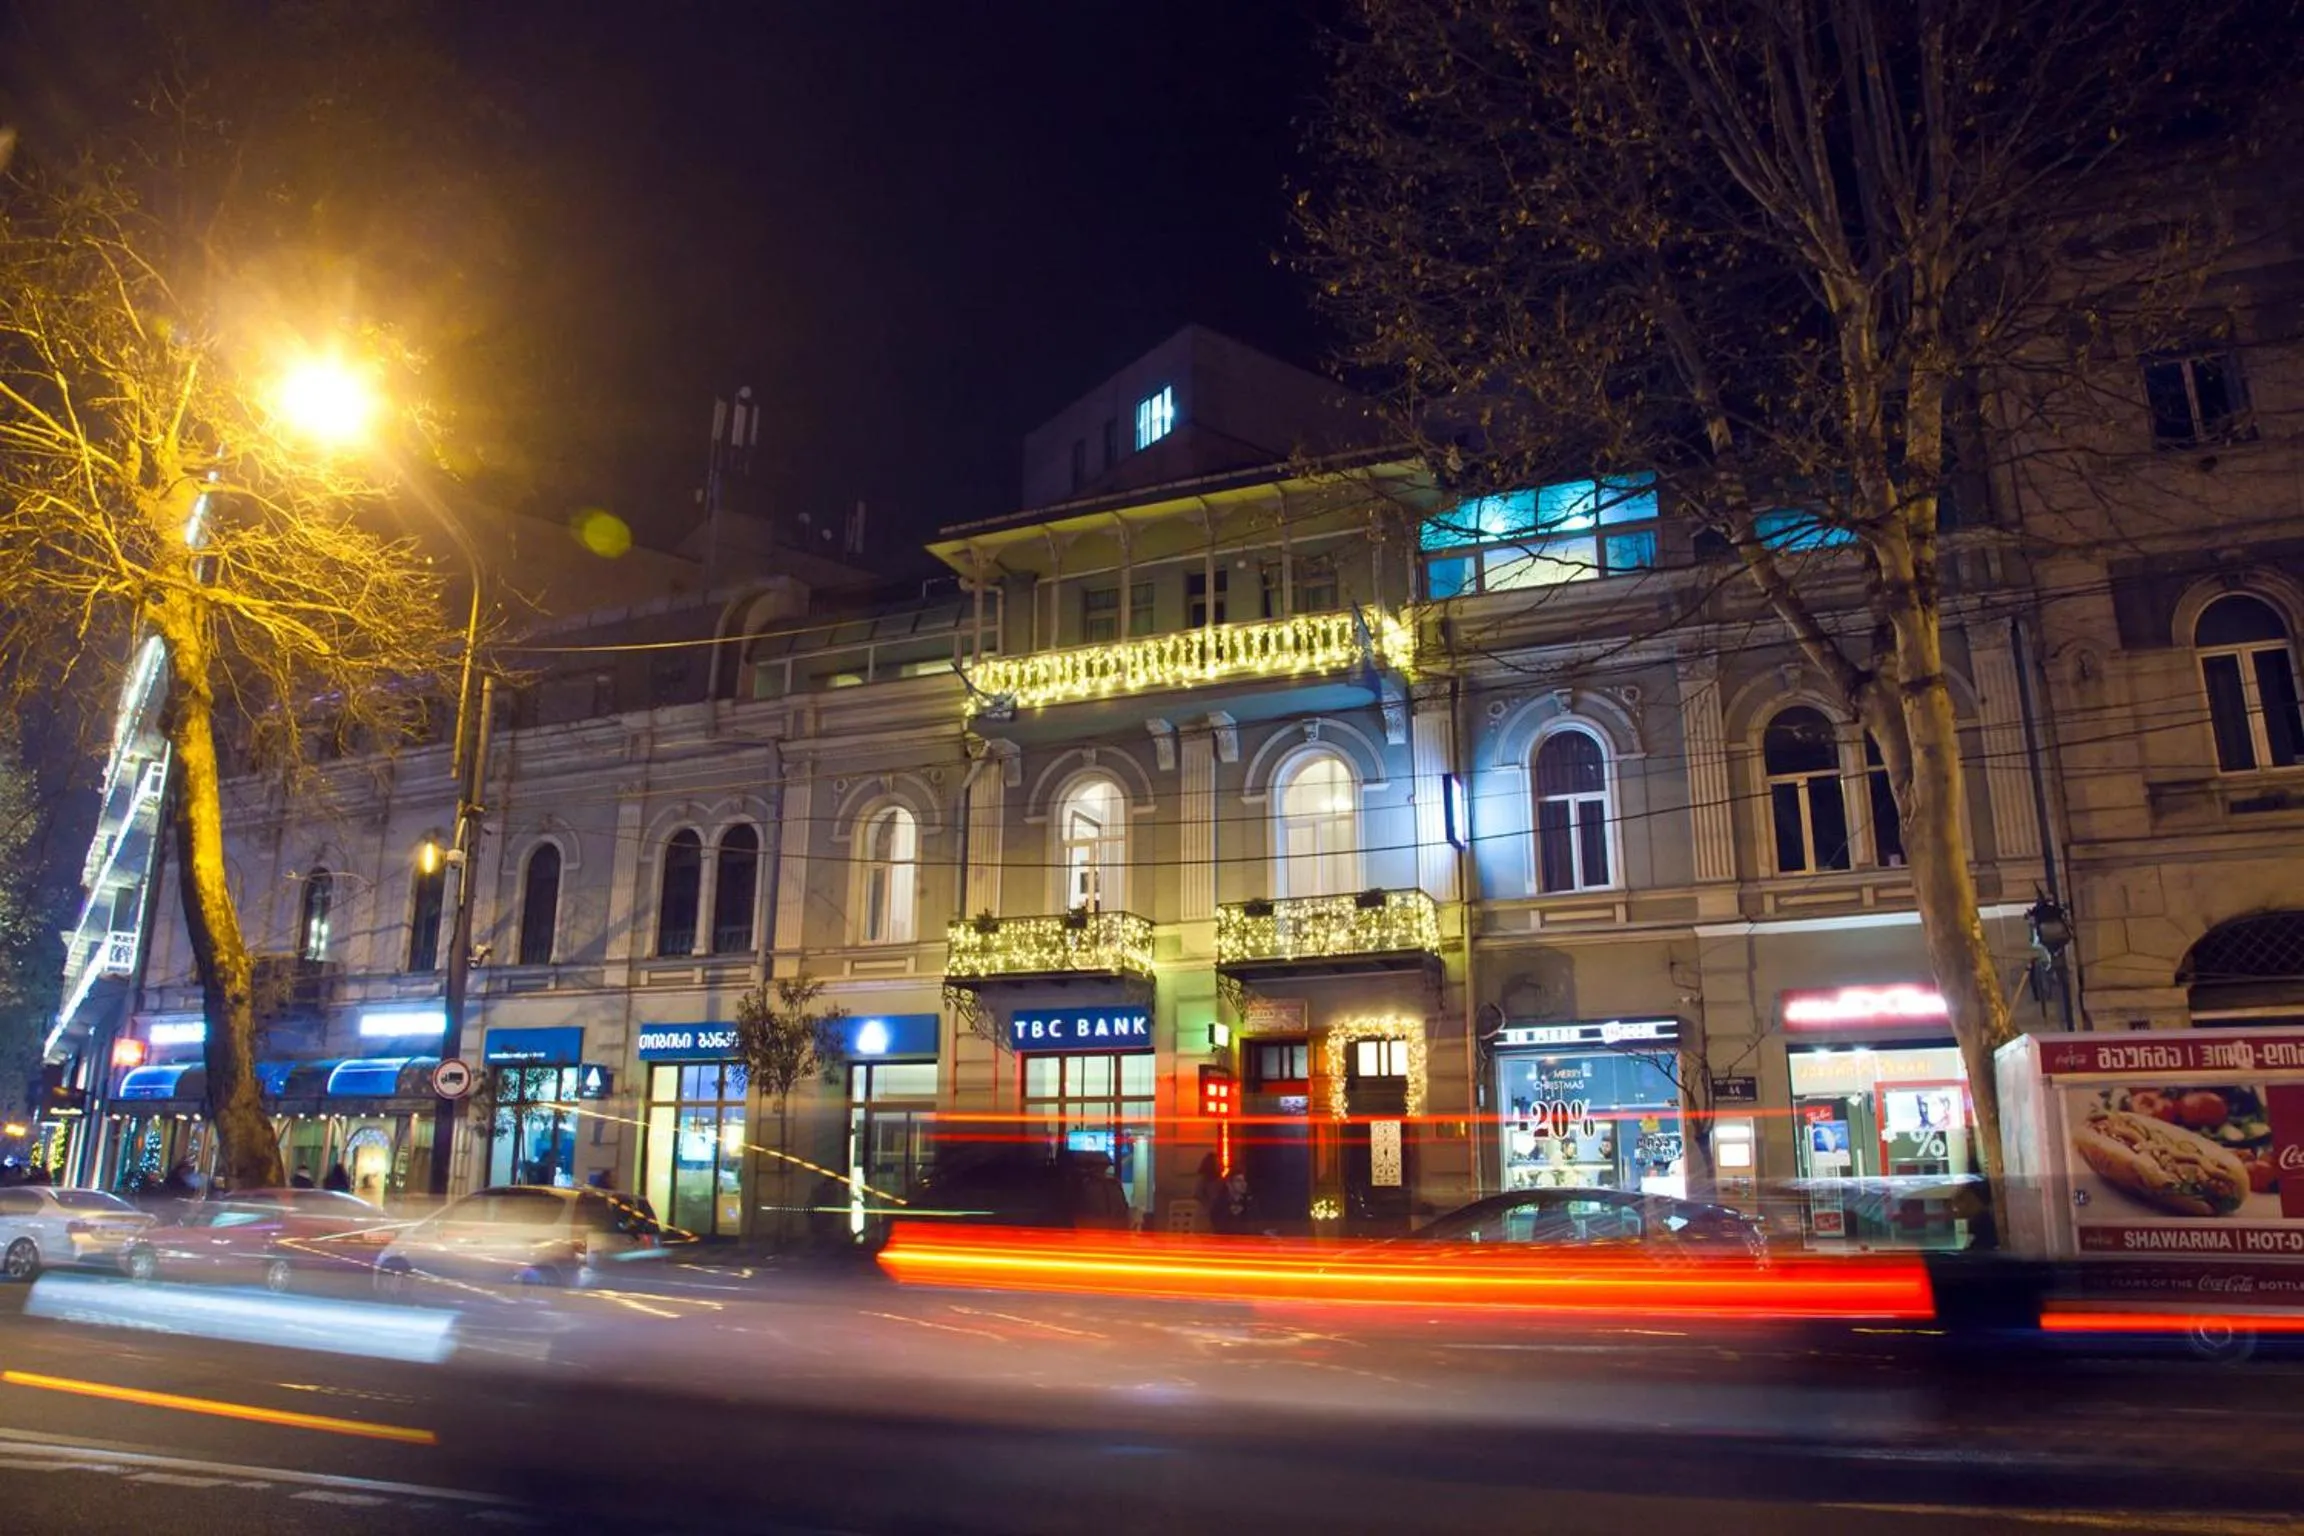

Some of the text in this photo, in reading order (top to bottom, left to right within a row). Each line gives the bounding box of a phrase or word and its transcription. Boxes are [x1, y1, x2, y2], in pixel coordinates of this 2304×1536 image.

[1014, 1016, 1147, 1039] TBC BANK
[2124, 1230, 2231, 1249] SHAWARMA
